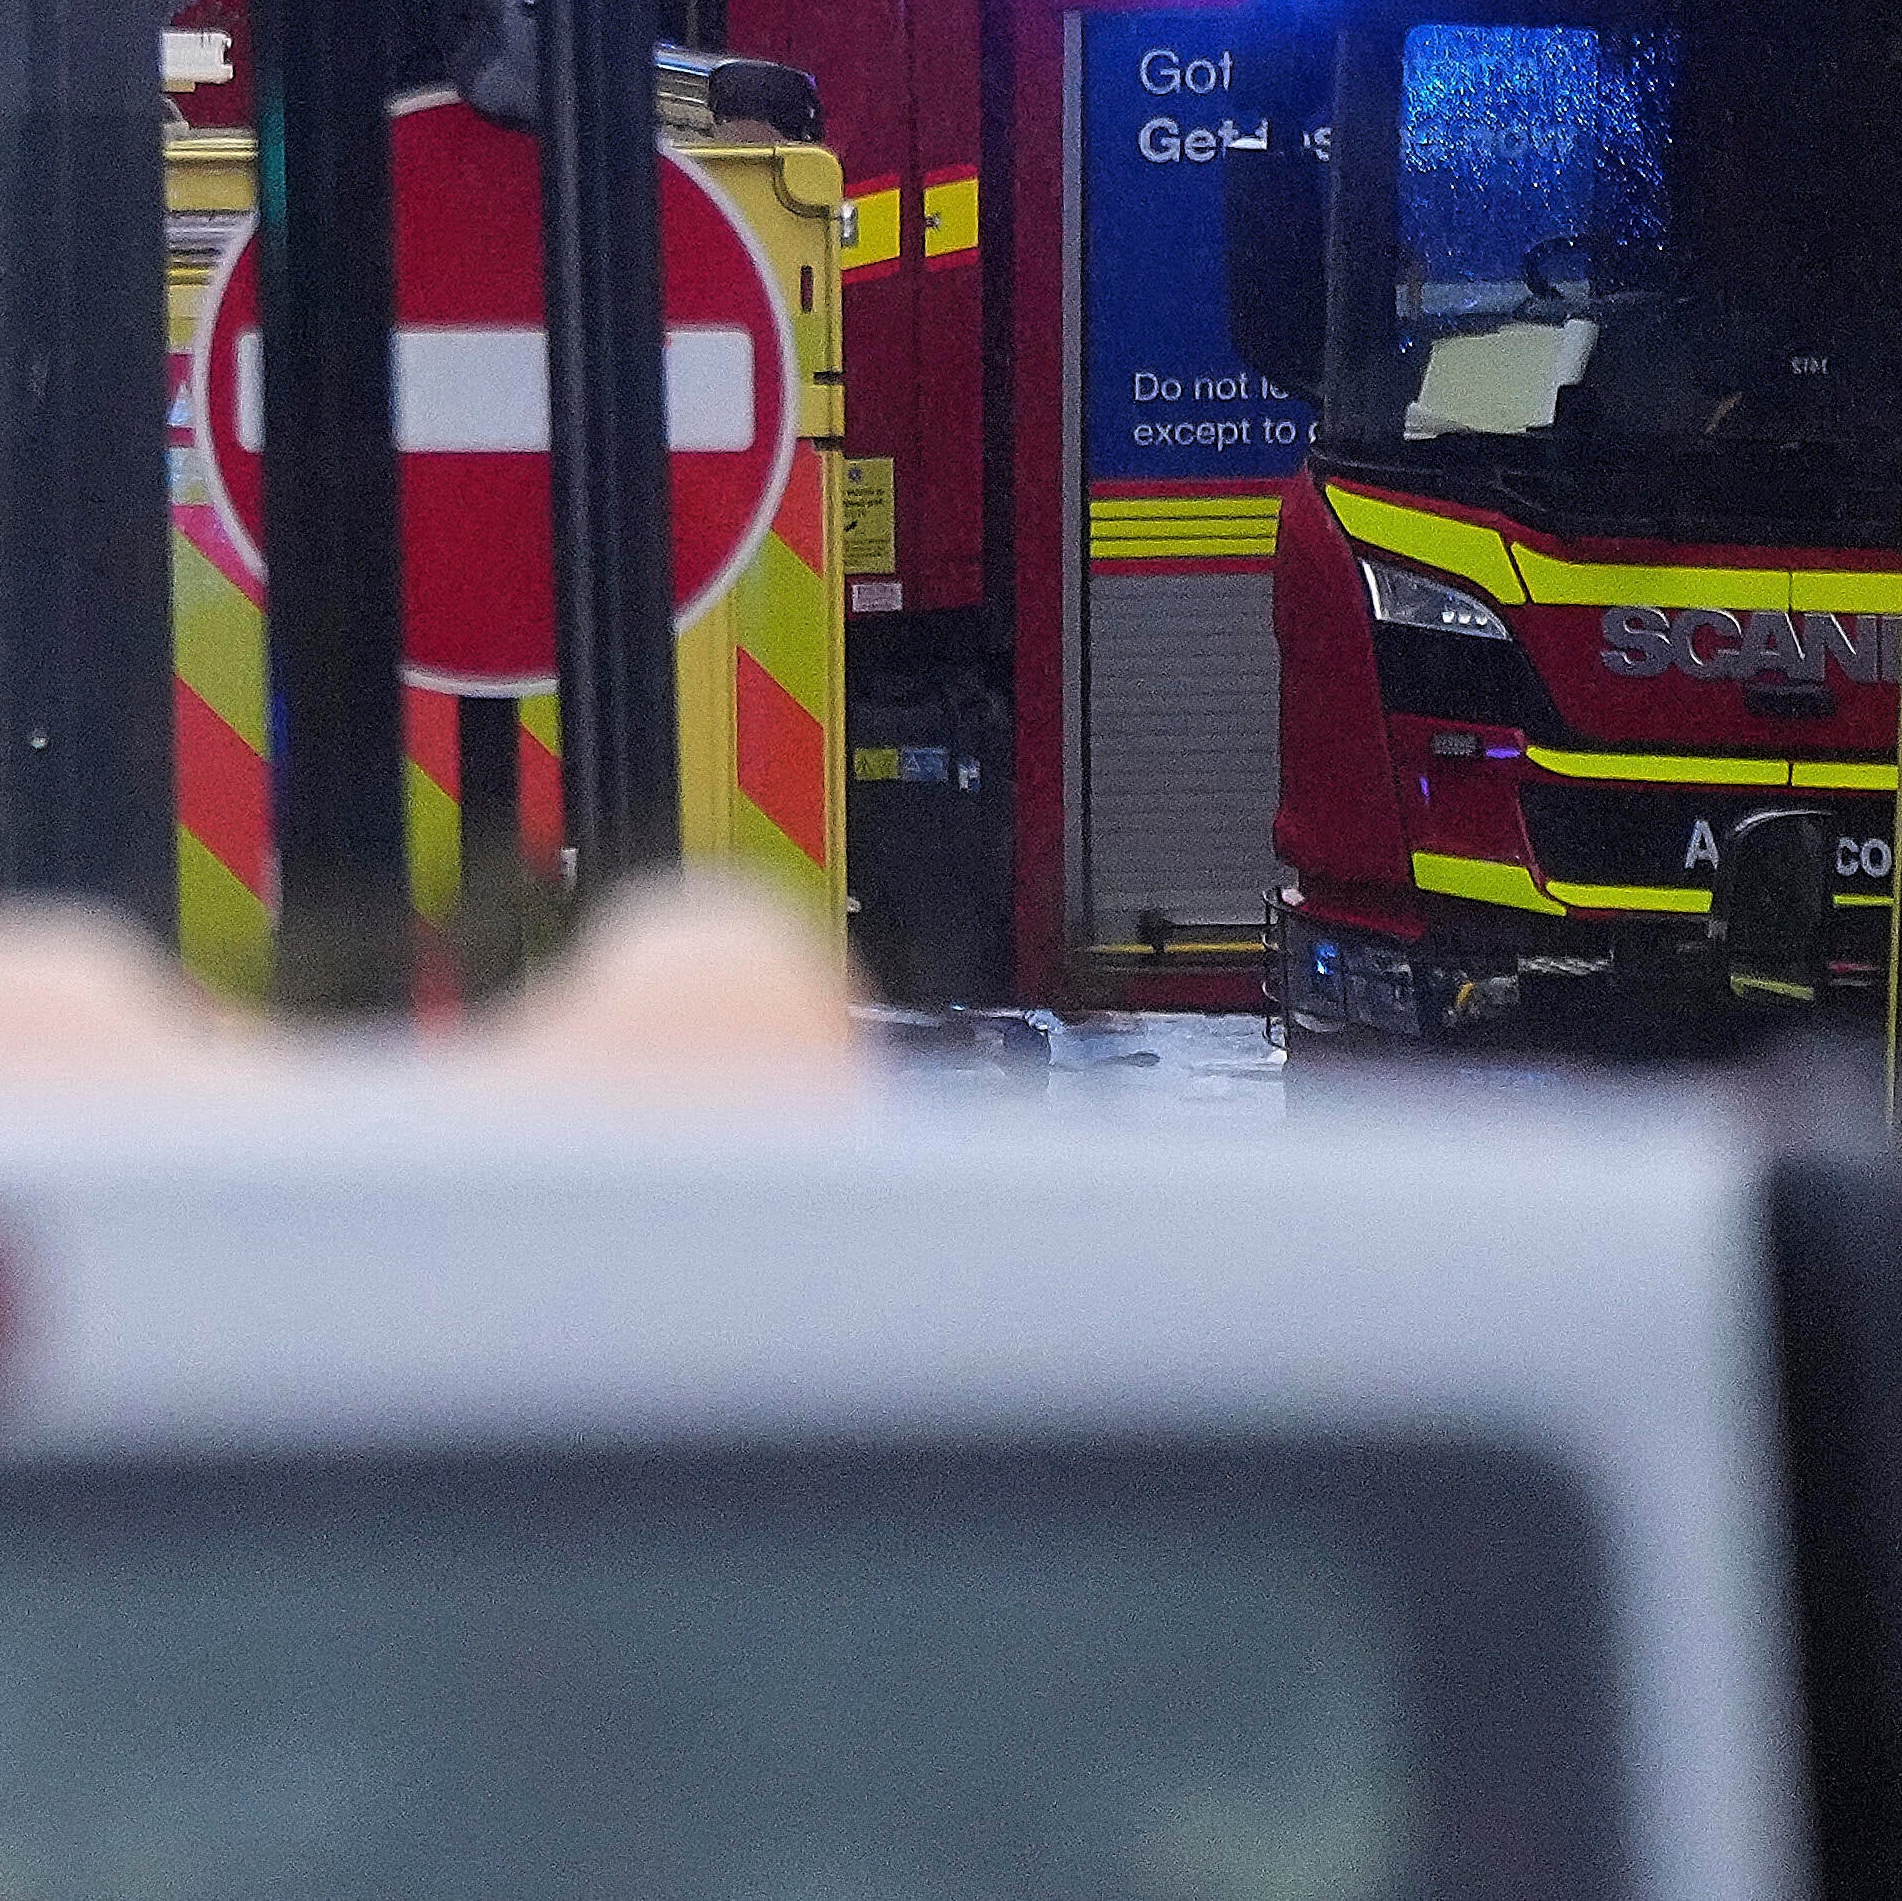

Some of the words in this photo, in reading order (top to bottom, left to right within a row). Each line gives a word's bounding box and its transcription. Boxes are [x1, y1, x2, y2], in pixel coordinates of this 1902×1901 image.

[1138, 49, 1234, 95] Got
[1133, 371, 1182, 401] Do
[1194, 371, 1249, 400] not
[1132, 417, 1252, 452] except
[1262, 417, 1297, 444] to
[1600, 605, 1901, 684] SCANI
